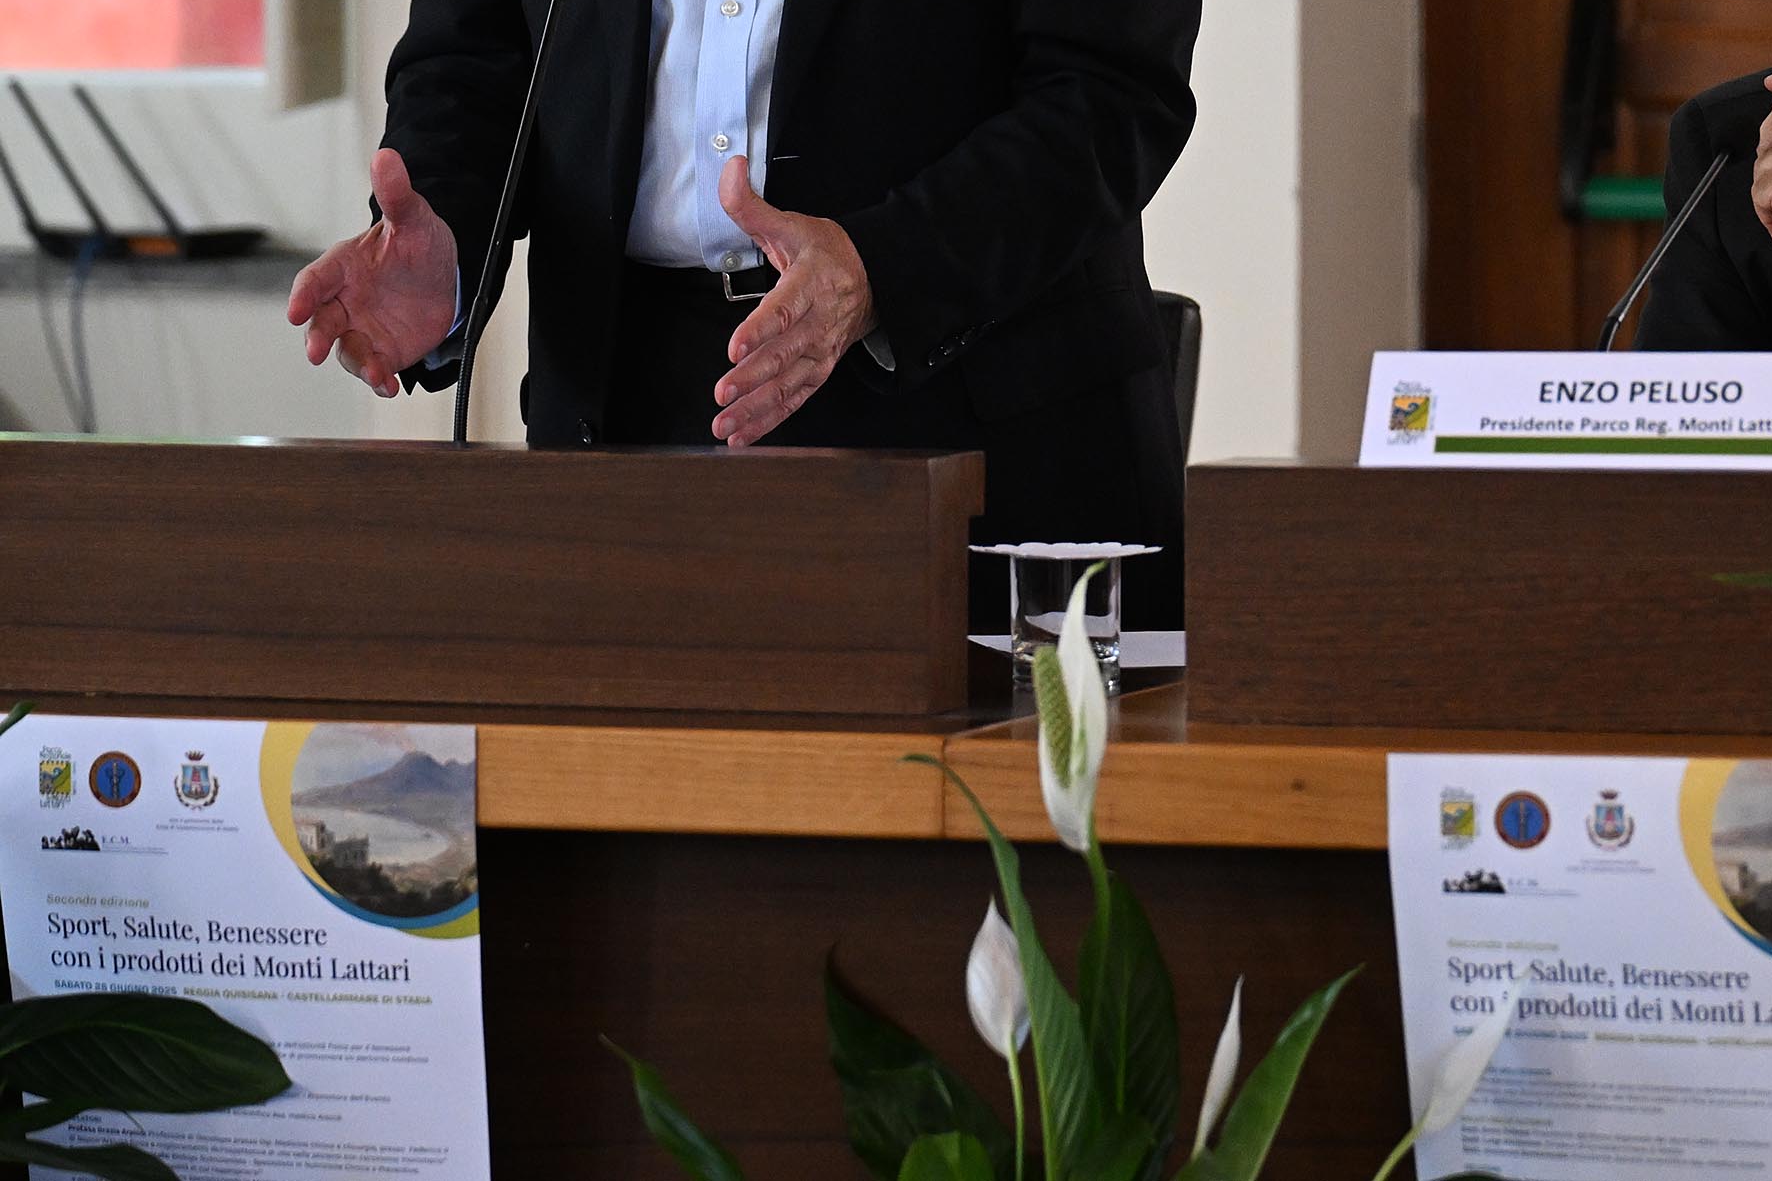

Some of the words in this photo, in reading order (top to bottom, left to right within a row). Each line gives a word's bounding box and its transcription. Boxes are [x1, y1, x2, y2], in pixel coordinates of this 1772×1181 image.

[1538, 380, 1620, 404] ENZO
[1629, 380, 1744, 404] PELUSO
[1479, 416, 1577, 433] Presidente
[1580, 417, 1631, 433] Parco
[1635, 417, 1674, 436] Reg.
[1679, 416, 1733, 433] Monti
[48, 912, 117, 939] Sport,
[123, 915, 201, 943] Salute,
[207, 919, 328, 946] Benessere
[51, 949, 91, 968] con
[99, 947, 105, 969] i
[112, 948, 203, 974] prodotti
[211, 953, 246, 976] dei
[254, 955, 322, 979] Monti
[331, 958, 411, 982] Lattari
[1529, 959, 1615, 987] Salute,
[1622, 962, 1750, 990] Benessere
[1450, 993, 1495, 1013] con
[1517, 993, 1618, 1020] prodotti
[1624, 995, 1663, 1021] dei
[1671, 999, 1746, 1024] Monti
